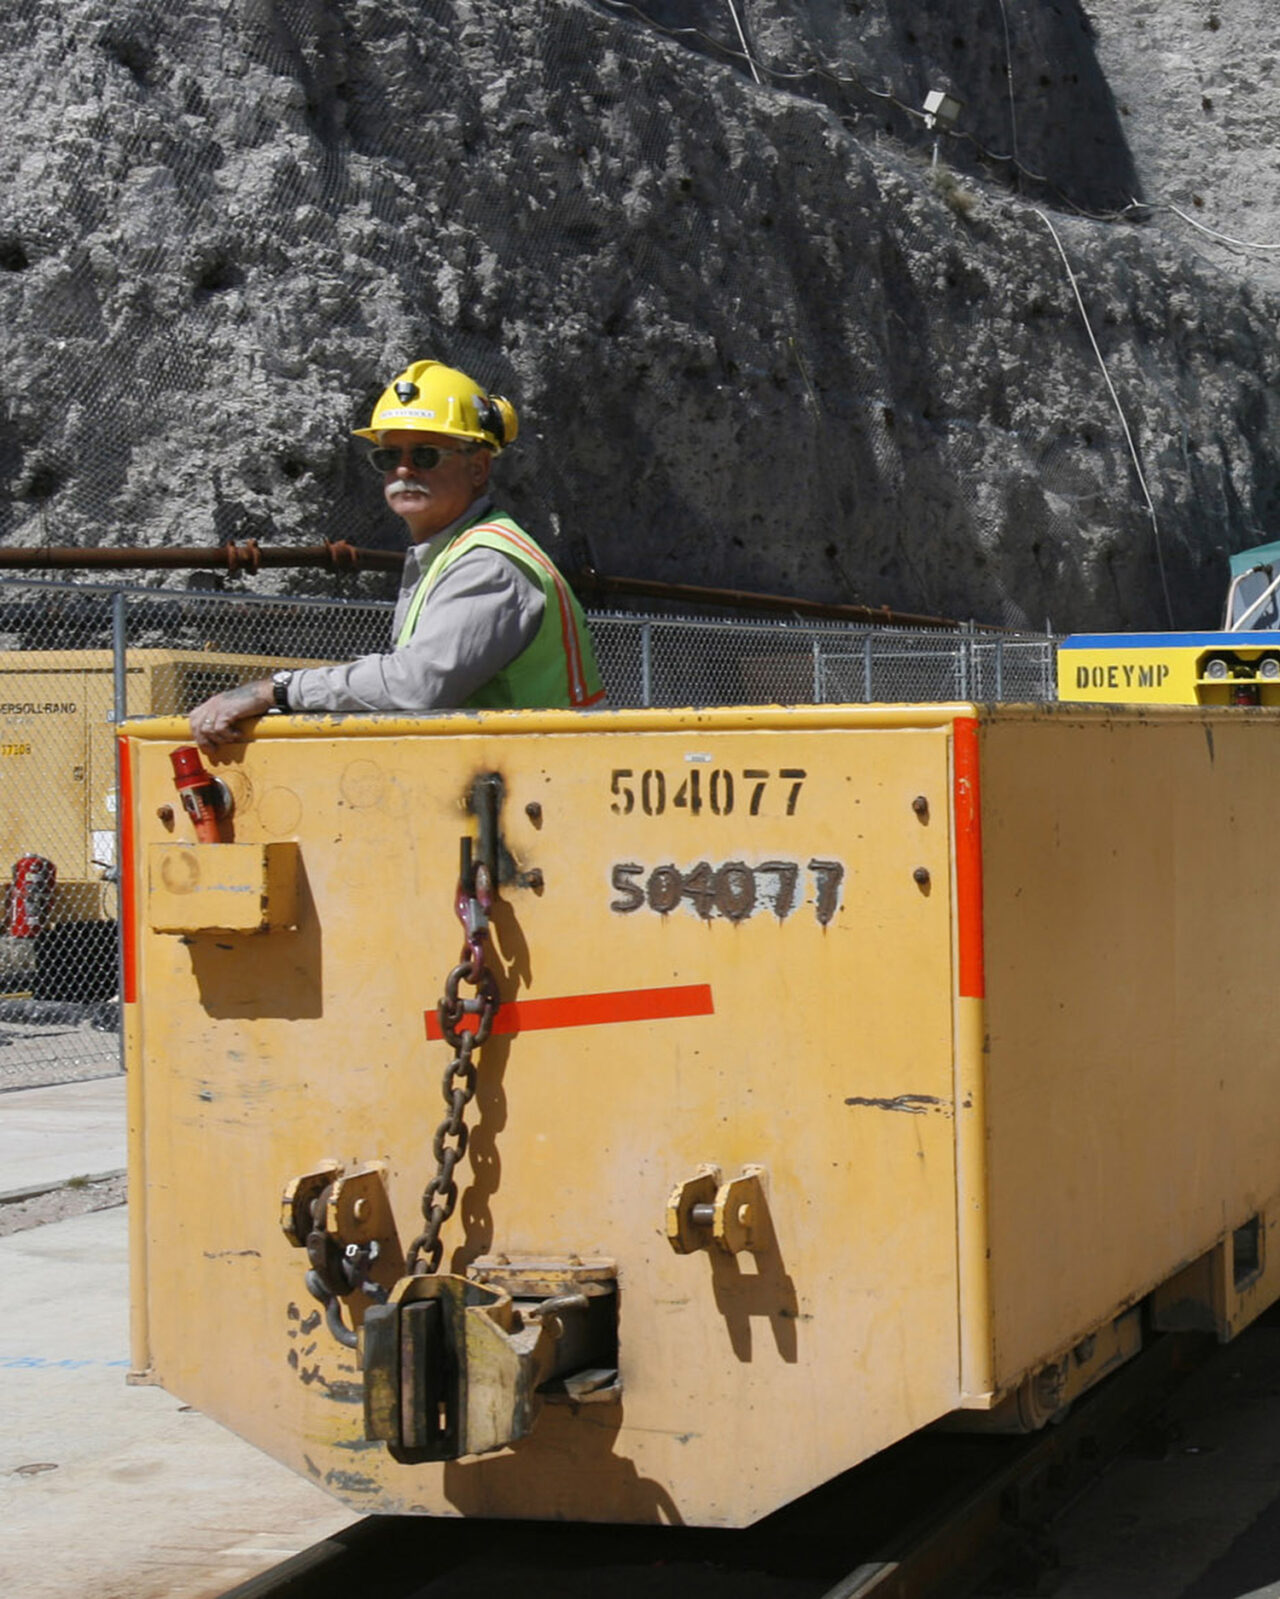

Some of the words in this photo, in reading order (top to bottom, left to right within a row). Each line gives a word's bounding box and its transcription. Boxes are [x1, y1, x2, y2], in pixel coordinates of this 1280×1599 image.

[1076, 664, 1170, 689] DOEYMP
[610, 768, 808, 817] 504077
[610, 857, 845, 925] 504077
